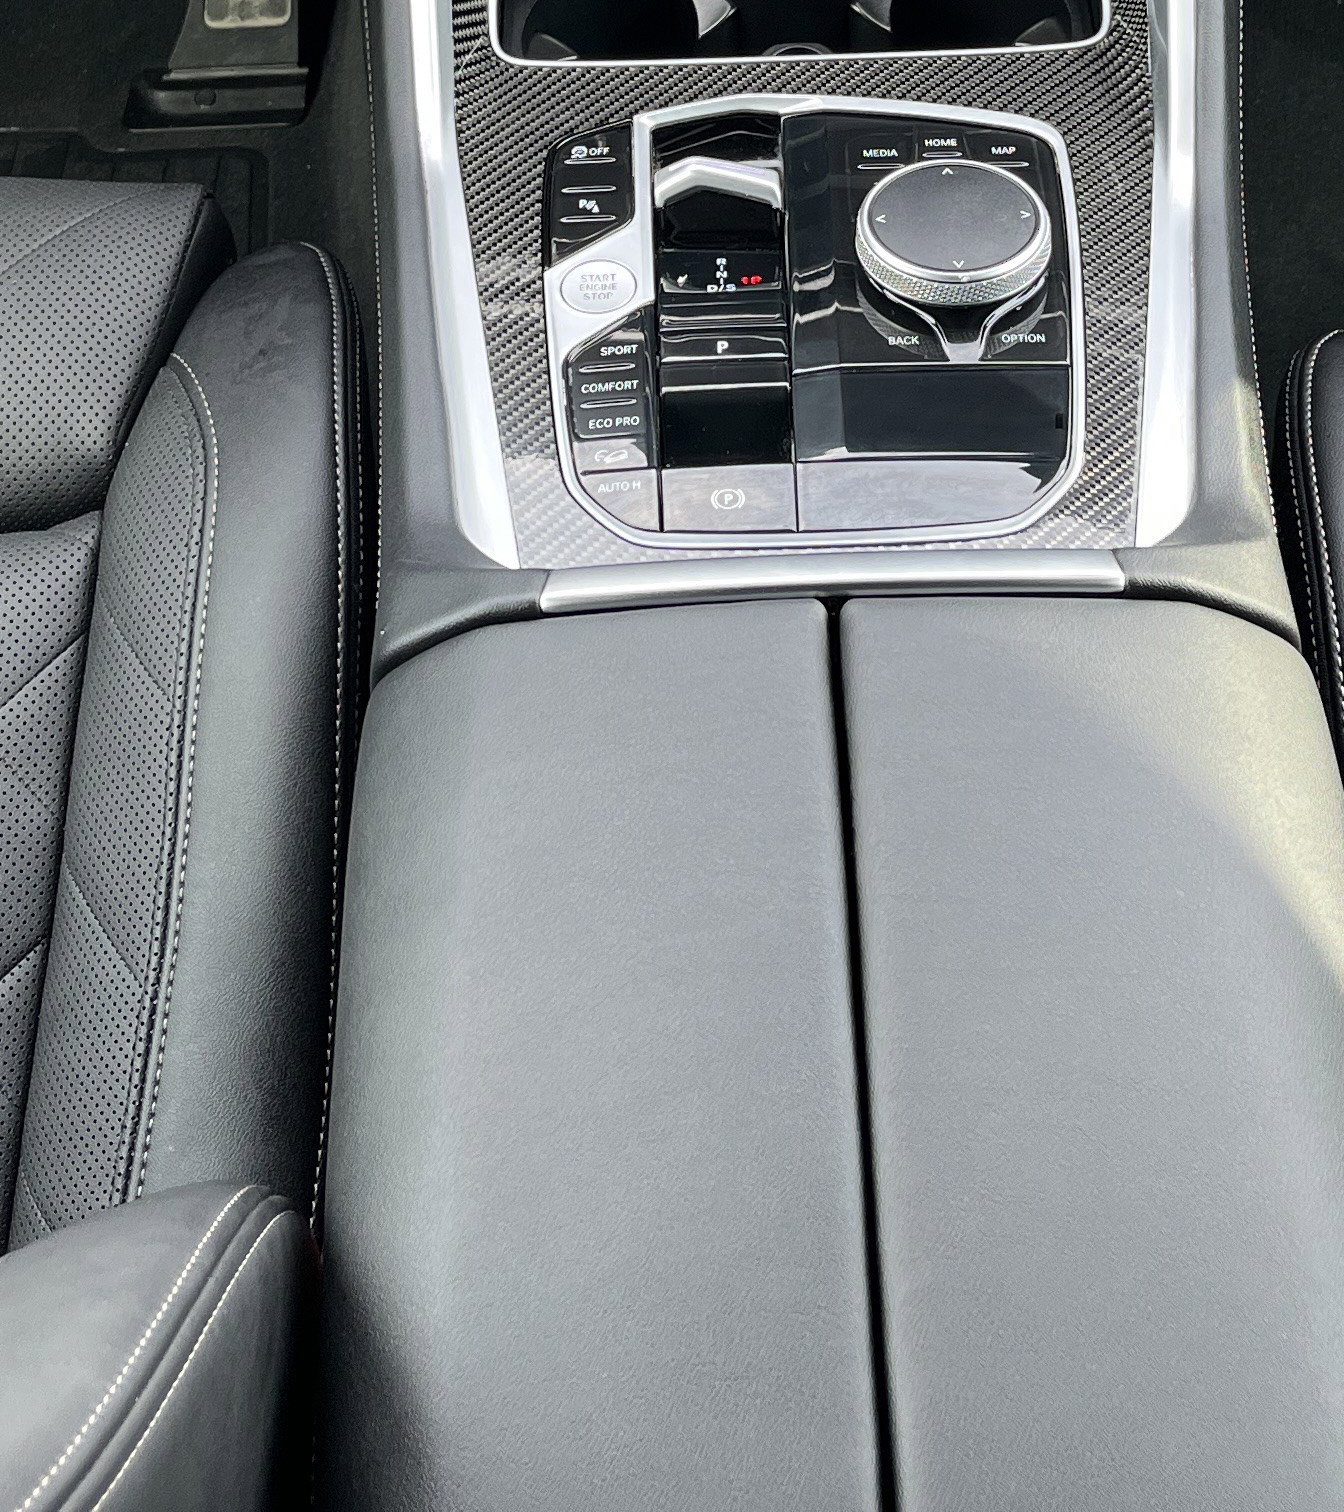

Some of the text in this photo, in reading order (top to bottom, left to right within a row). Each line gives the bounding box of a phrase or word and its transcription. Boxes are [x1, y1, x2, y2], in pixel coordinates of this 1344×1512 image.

[924, 139, 958, 147] HOME
[589, 147, 610, 156] OFF
[863, 148, 898, 158] MEDIA
[991, 146, 1016, 155] MAP
[581, 273, 616, 283] START
[716, 270, 727, 279] N
[579, 283, 617, 291] ENGINE
[583, 292, 613, 300] STOP
[888, 336, 920, 346] BACK
[1001, 333, 1045, 343] OPTION
[600, 344, 639, 356] SPORT
[717, 341, 729, 354] P
[581, 379, 639, 394] COMFORT
[588, 416, 640, 429] ECO PRO
[598, 481, 641, 493] AUTO H
